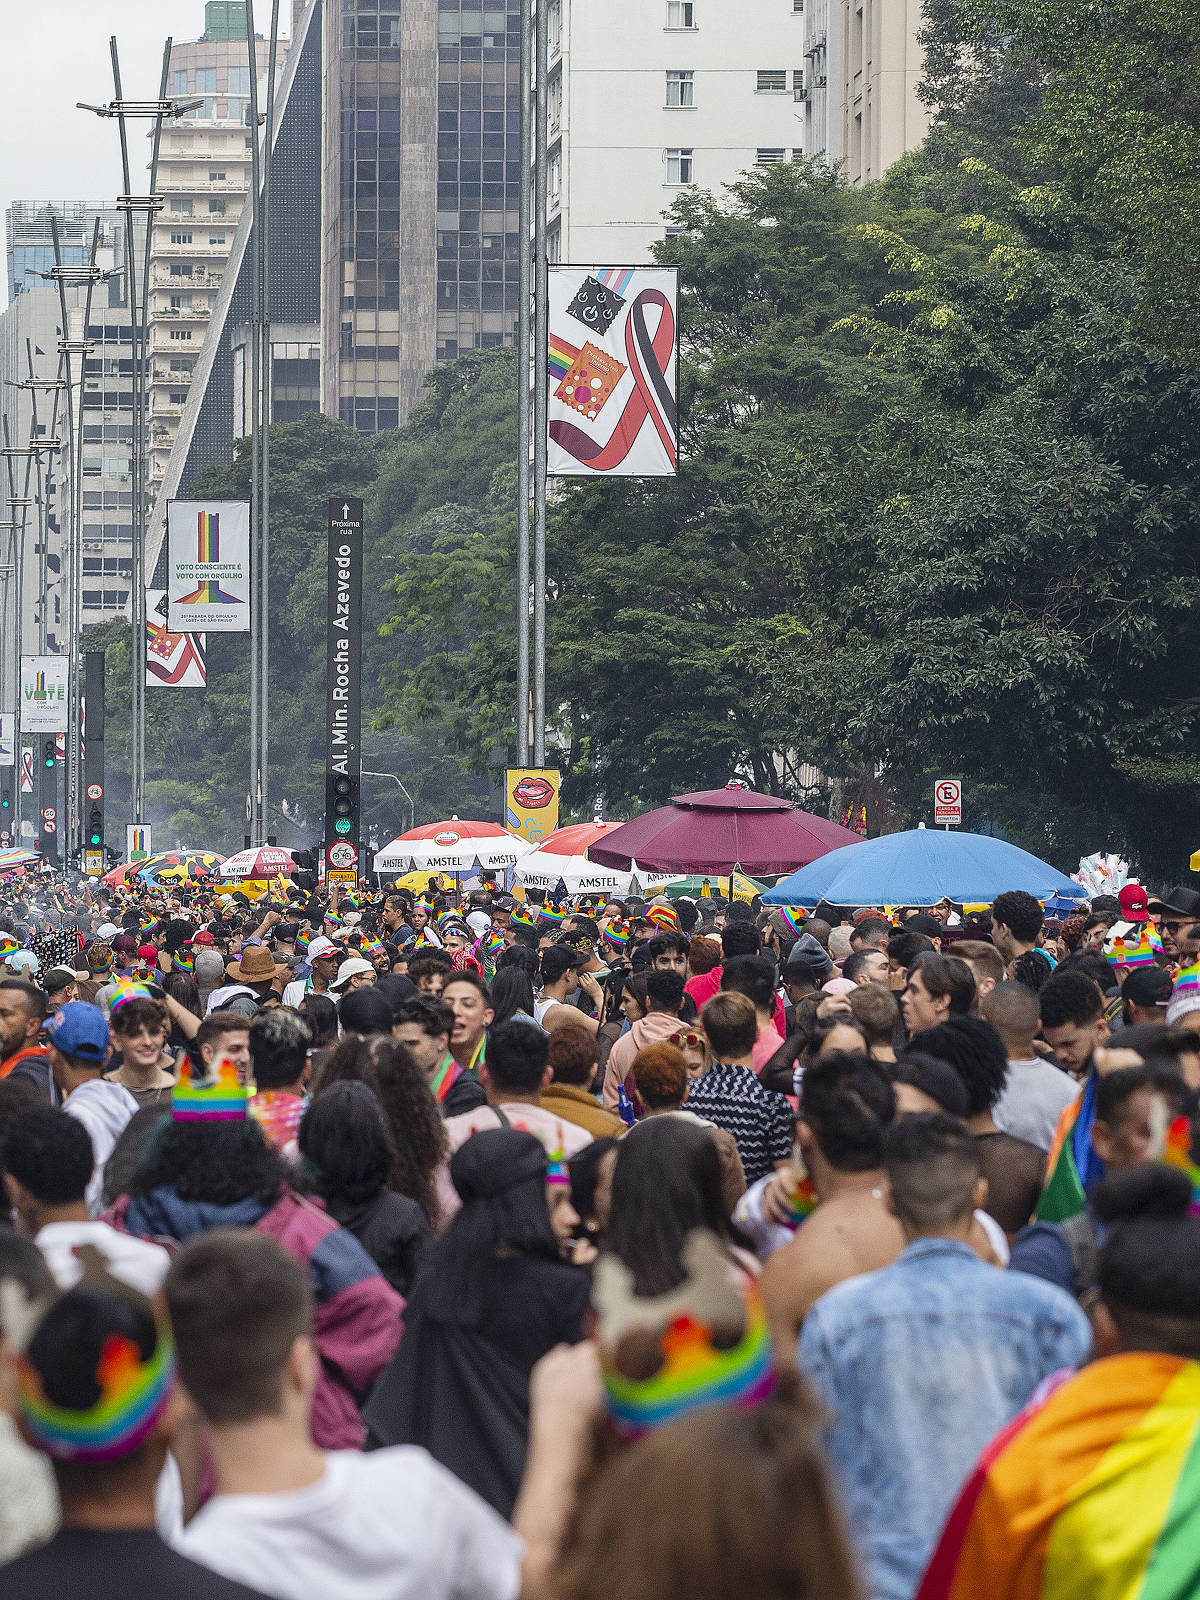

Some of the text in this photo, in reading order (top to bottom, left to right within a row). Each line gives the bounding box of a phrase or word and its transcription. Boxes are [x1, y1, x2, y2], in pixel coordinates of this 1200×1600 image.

[331, 520, 360, 528] Próxima
[237, 562, 242, 571] É
[332, 544, 352, 775] Al. Min. Rocha Azevedo
[382, 858, 403, 868] AMSTEL
[426, 857, 463, 867] AMSTEL
[488, 854, 518, 865] AMSTEL
[263, 864, 289, 872] AMSTEL
[578, 877, 619, 888] AMSTEL
